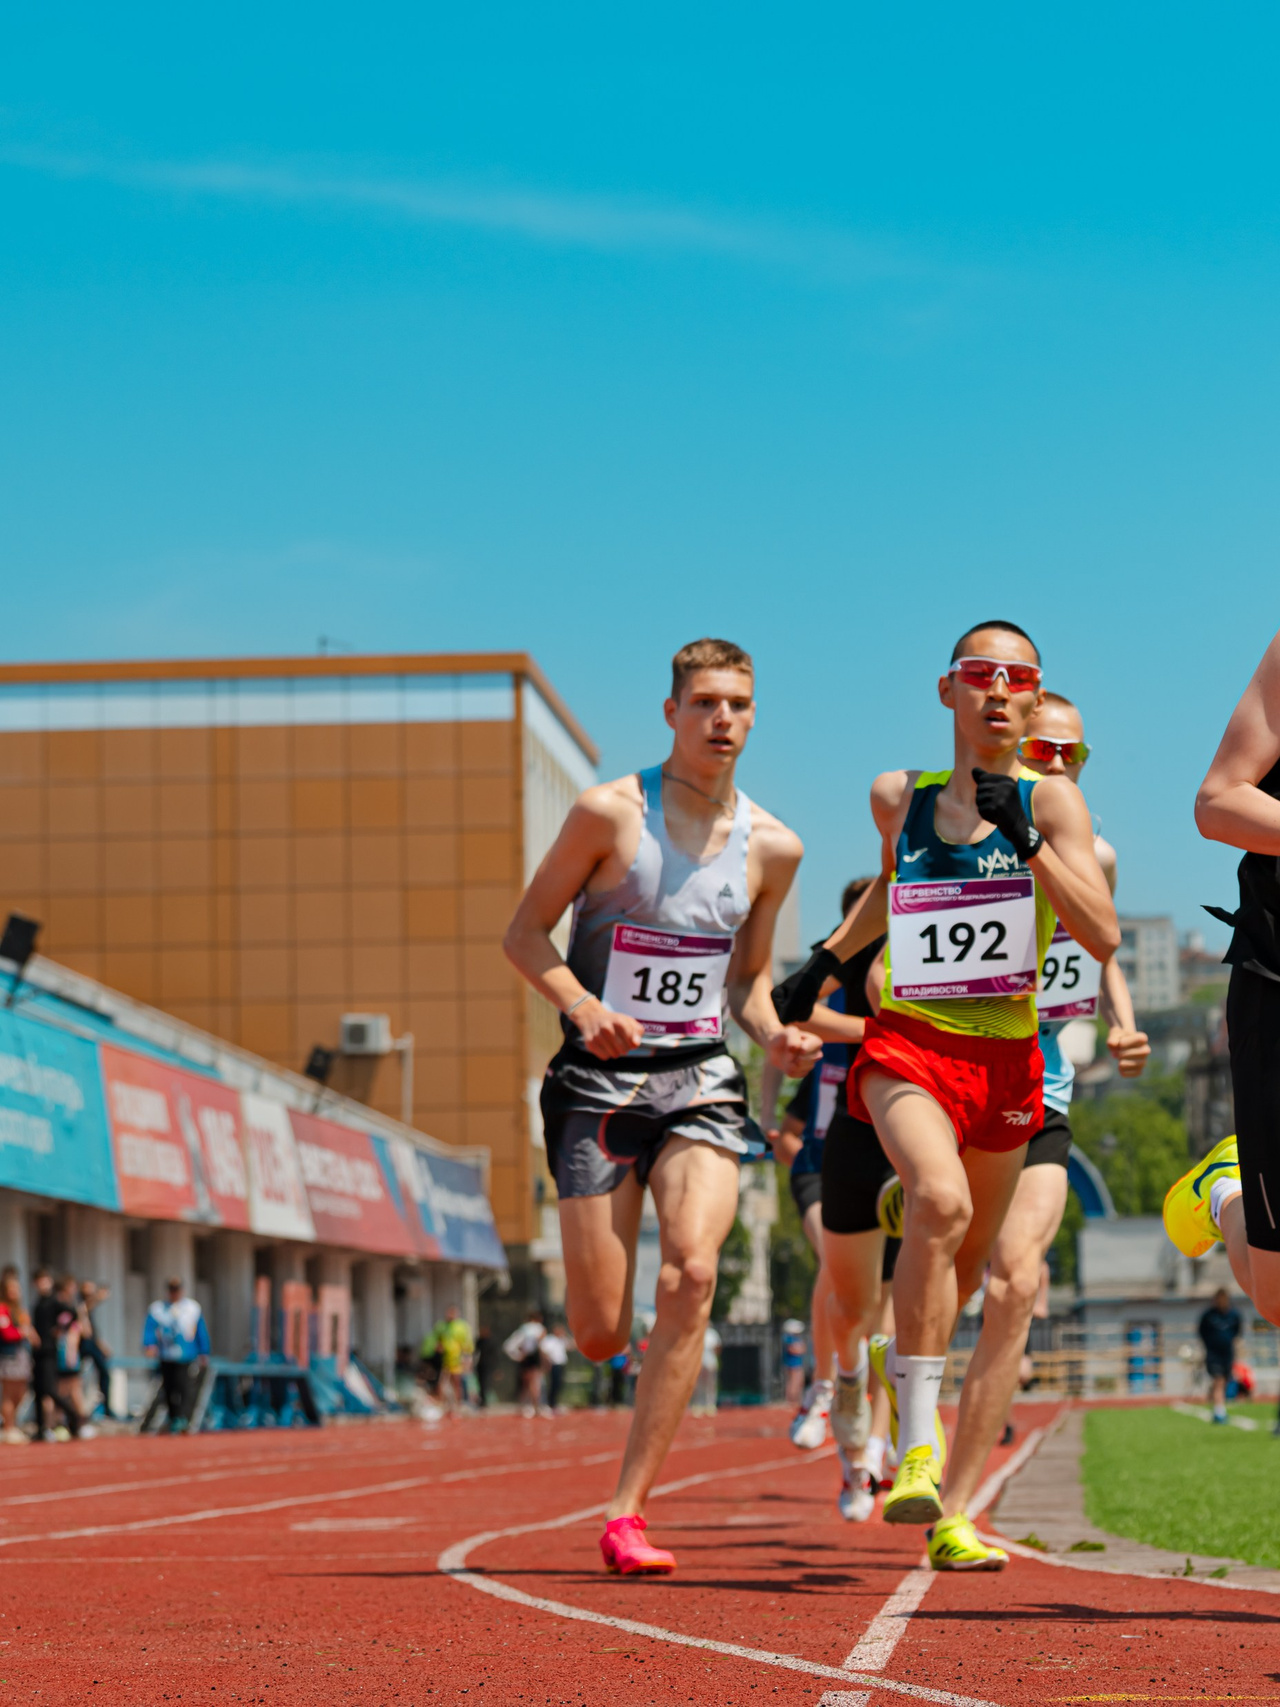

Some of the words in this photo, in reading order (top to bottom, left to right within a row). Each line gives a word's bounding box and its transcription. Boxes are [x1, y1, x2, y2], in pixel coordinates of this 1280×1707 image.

[900, 886, 962, 898] ПЕРВЕНСТВО
[900, 895, 957, 904] ВОСТОЧНОГО
[919, 921, 1009, 963] 192
[1041, 955, 1081, 991] 95
[632, 967, 707, 1007] 185
[902, 985, 968, 996] ВЛАДИВОСТОК
